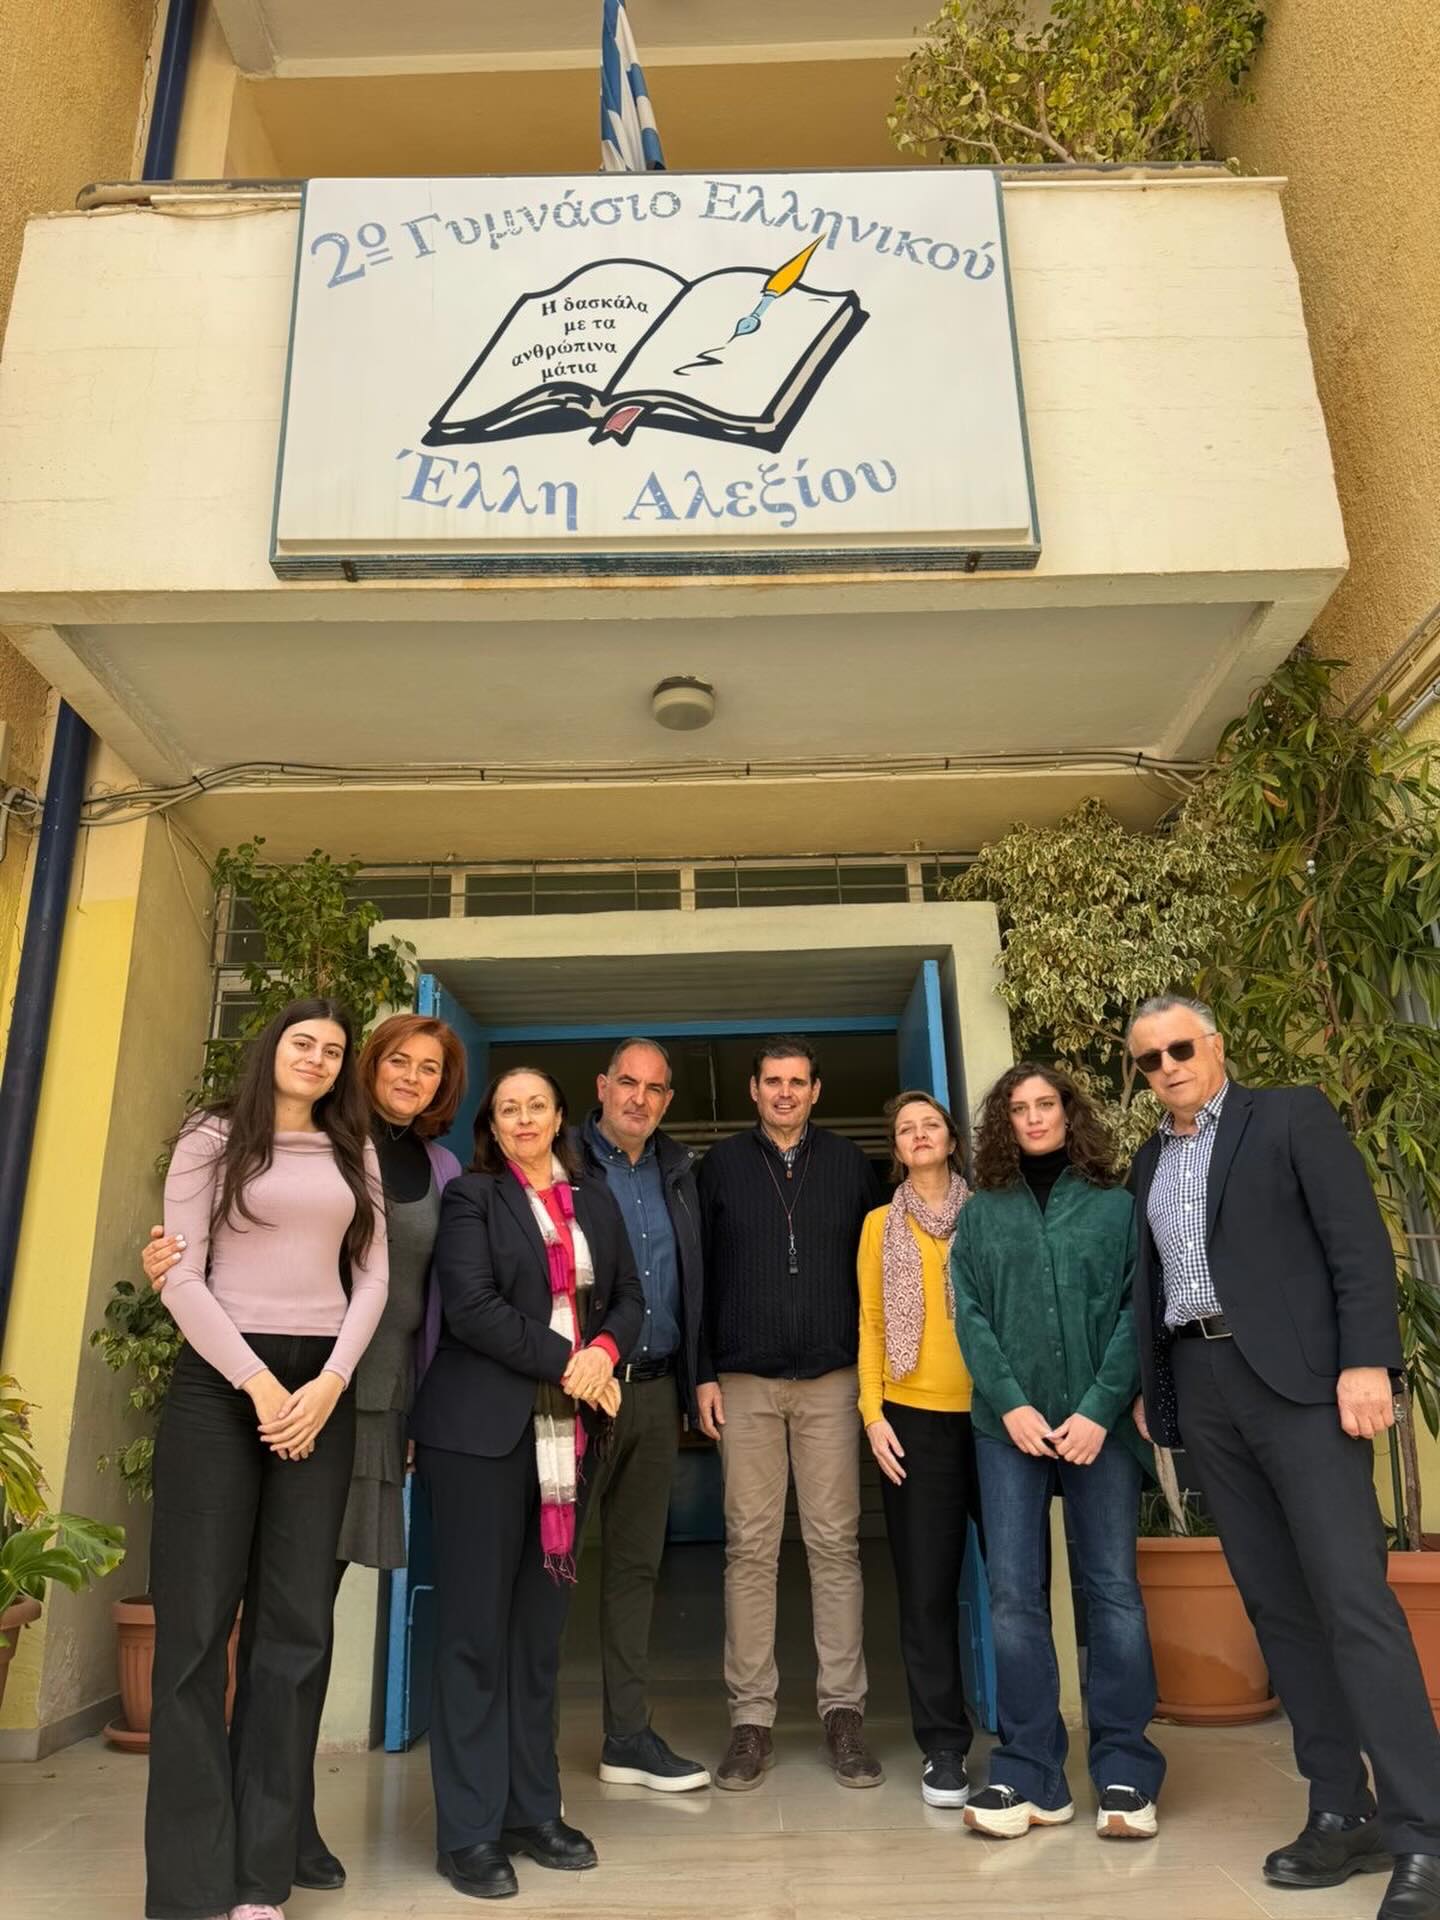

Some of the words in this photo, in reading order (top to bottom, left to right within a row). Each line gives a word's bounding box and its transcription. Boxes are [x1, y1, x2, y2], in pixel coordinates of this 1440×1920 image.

[401, 189, 682, 259] Γυμνάσιο
[698, 180, 996, 281] Ελληνικού
[541, 300, 557, 317] Η
[563, 294, 649, 314] δασκάλα
[564, 319, 586, 335] με
[592, 318, 616, 330] τα
[511, 339, 618, 367] ανθρώπινα
[541, 361, 598, 382] μάτια
[395, 448, 578, 531] Έλλη
[622, 458, 898, 528] Αλεξίου
